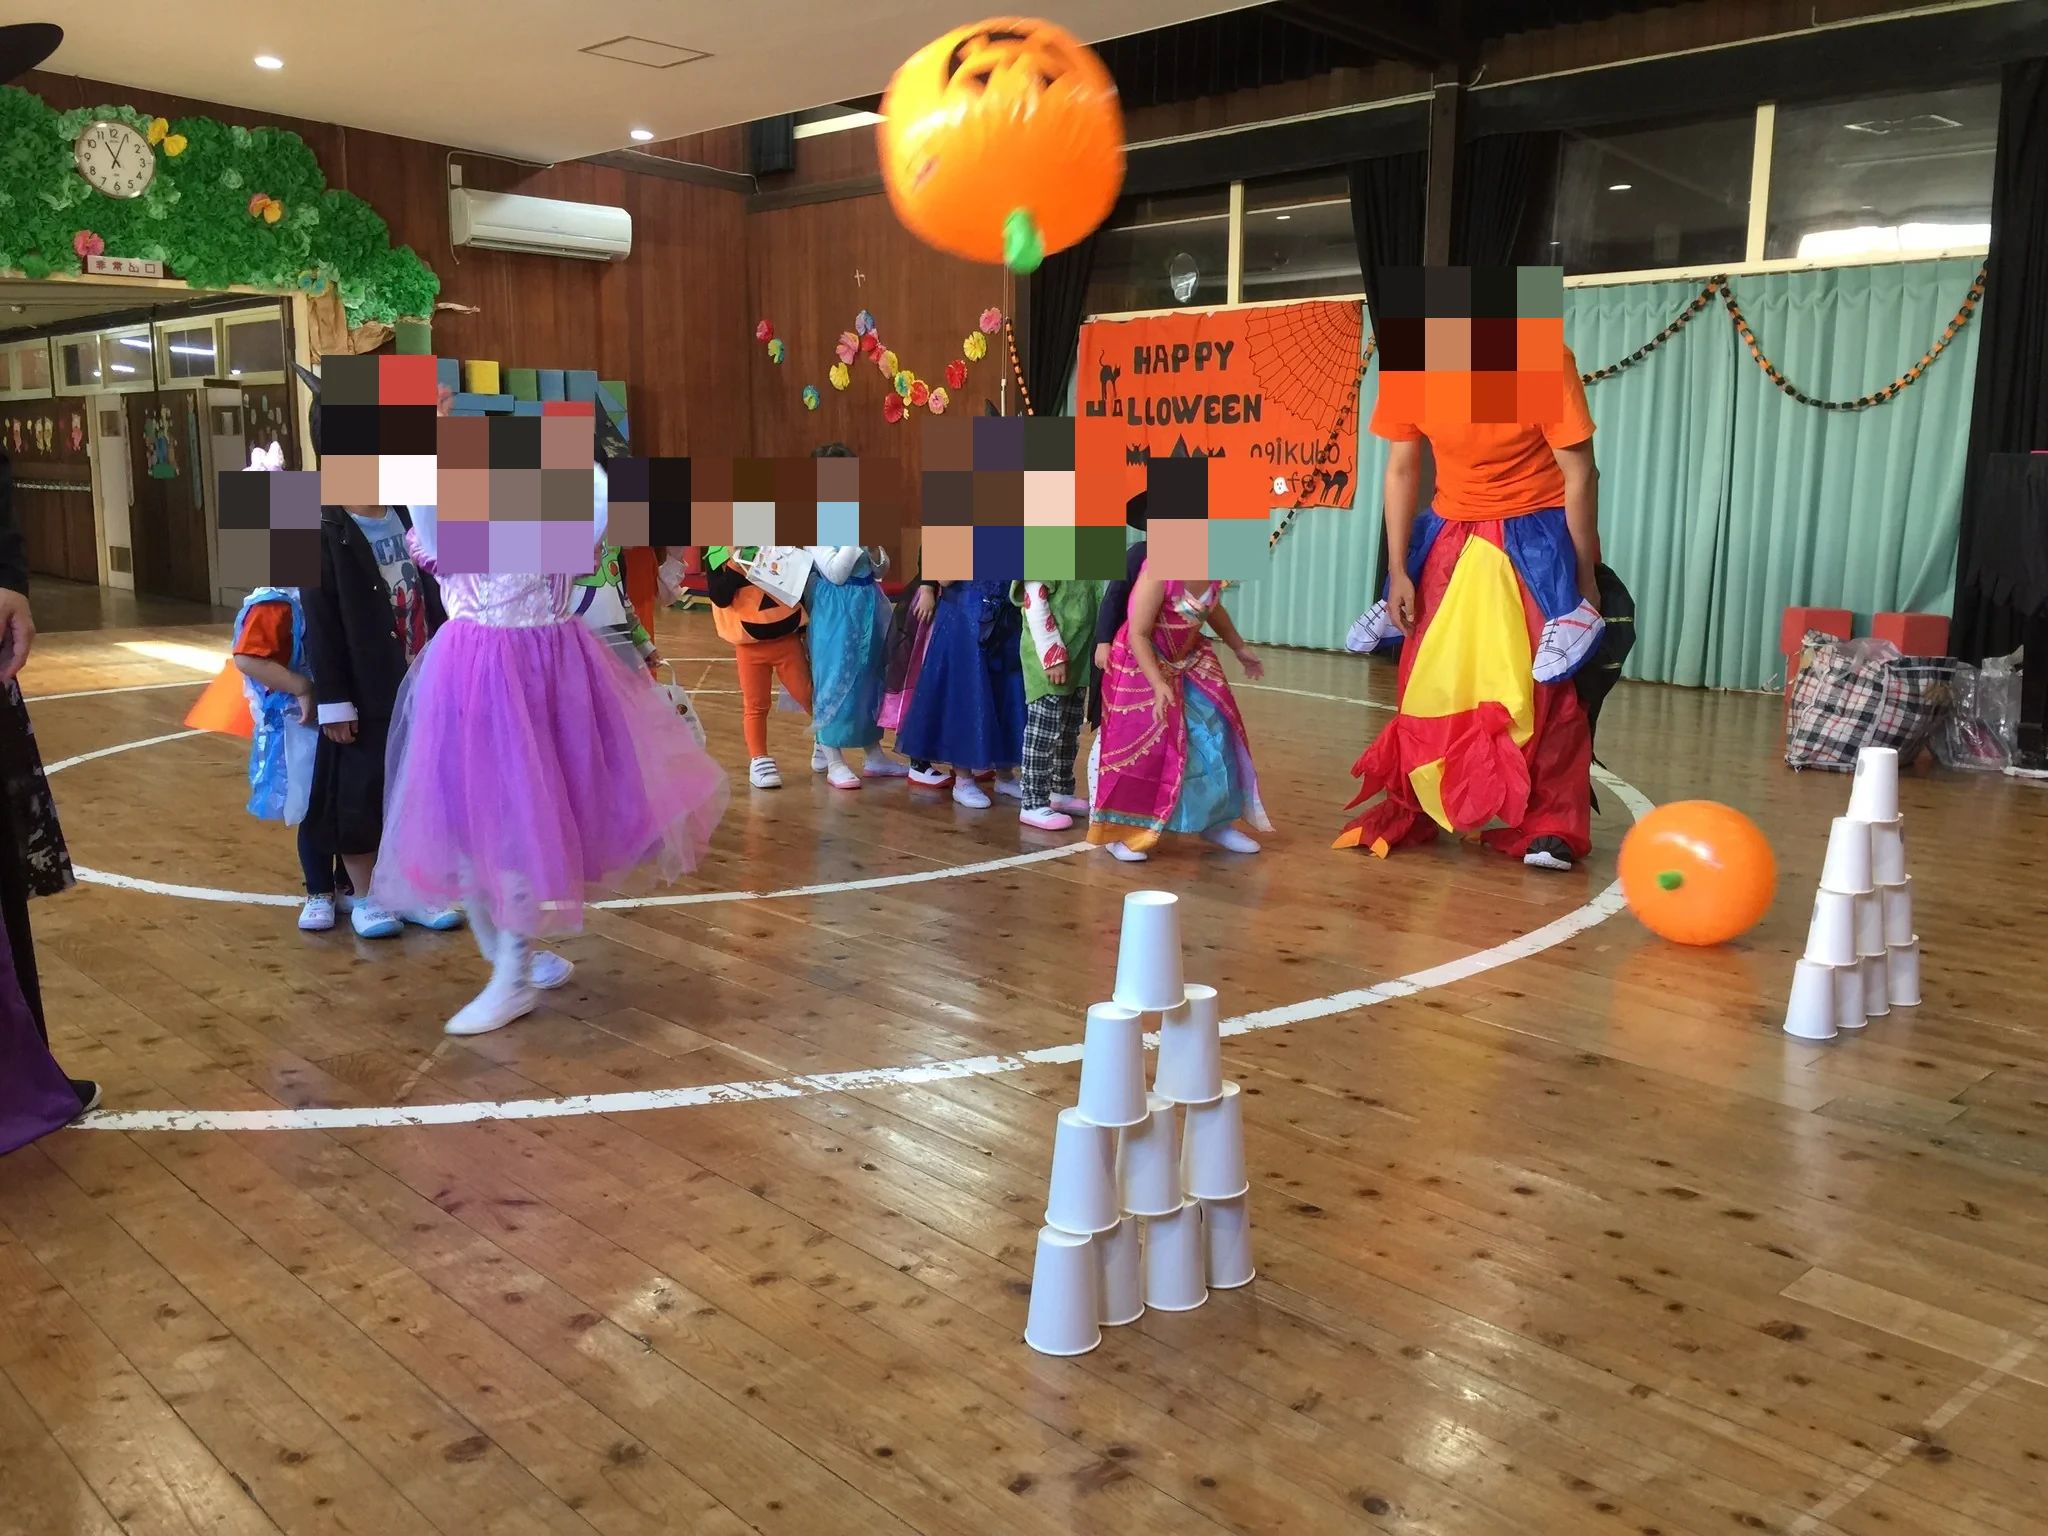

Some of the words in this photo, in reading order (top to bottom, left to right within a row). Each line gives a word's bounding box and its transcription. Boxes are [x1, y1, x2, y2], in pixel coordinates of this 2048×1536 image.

[96, 130, 105, 140] 11
[109, 128, 118, 138] 12
[87, 139, 97, 148] 10
[134, 144, 141, 153] 2
[84, 152, 91, 161] 9
[139, 158, 146, 168] 3
[89, 166, 96, 175] 8
[136, 171, 143, 180] 4
[101, 177, 107, 186] 7
[113, 181, 121, 191] 6
[127, 179, 134, 189] 5
[95, 260, 156, 274] 非常出口
[1133, 340, 1235, 375] HAPPY
